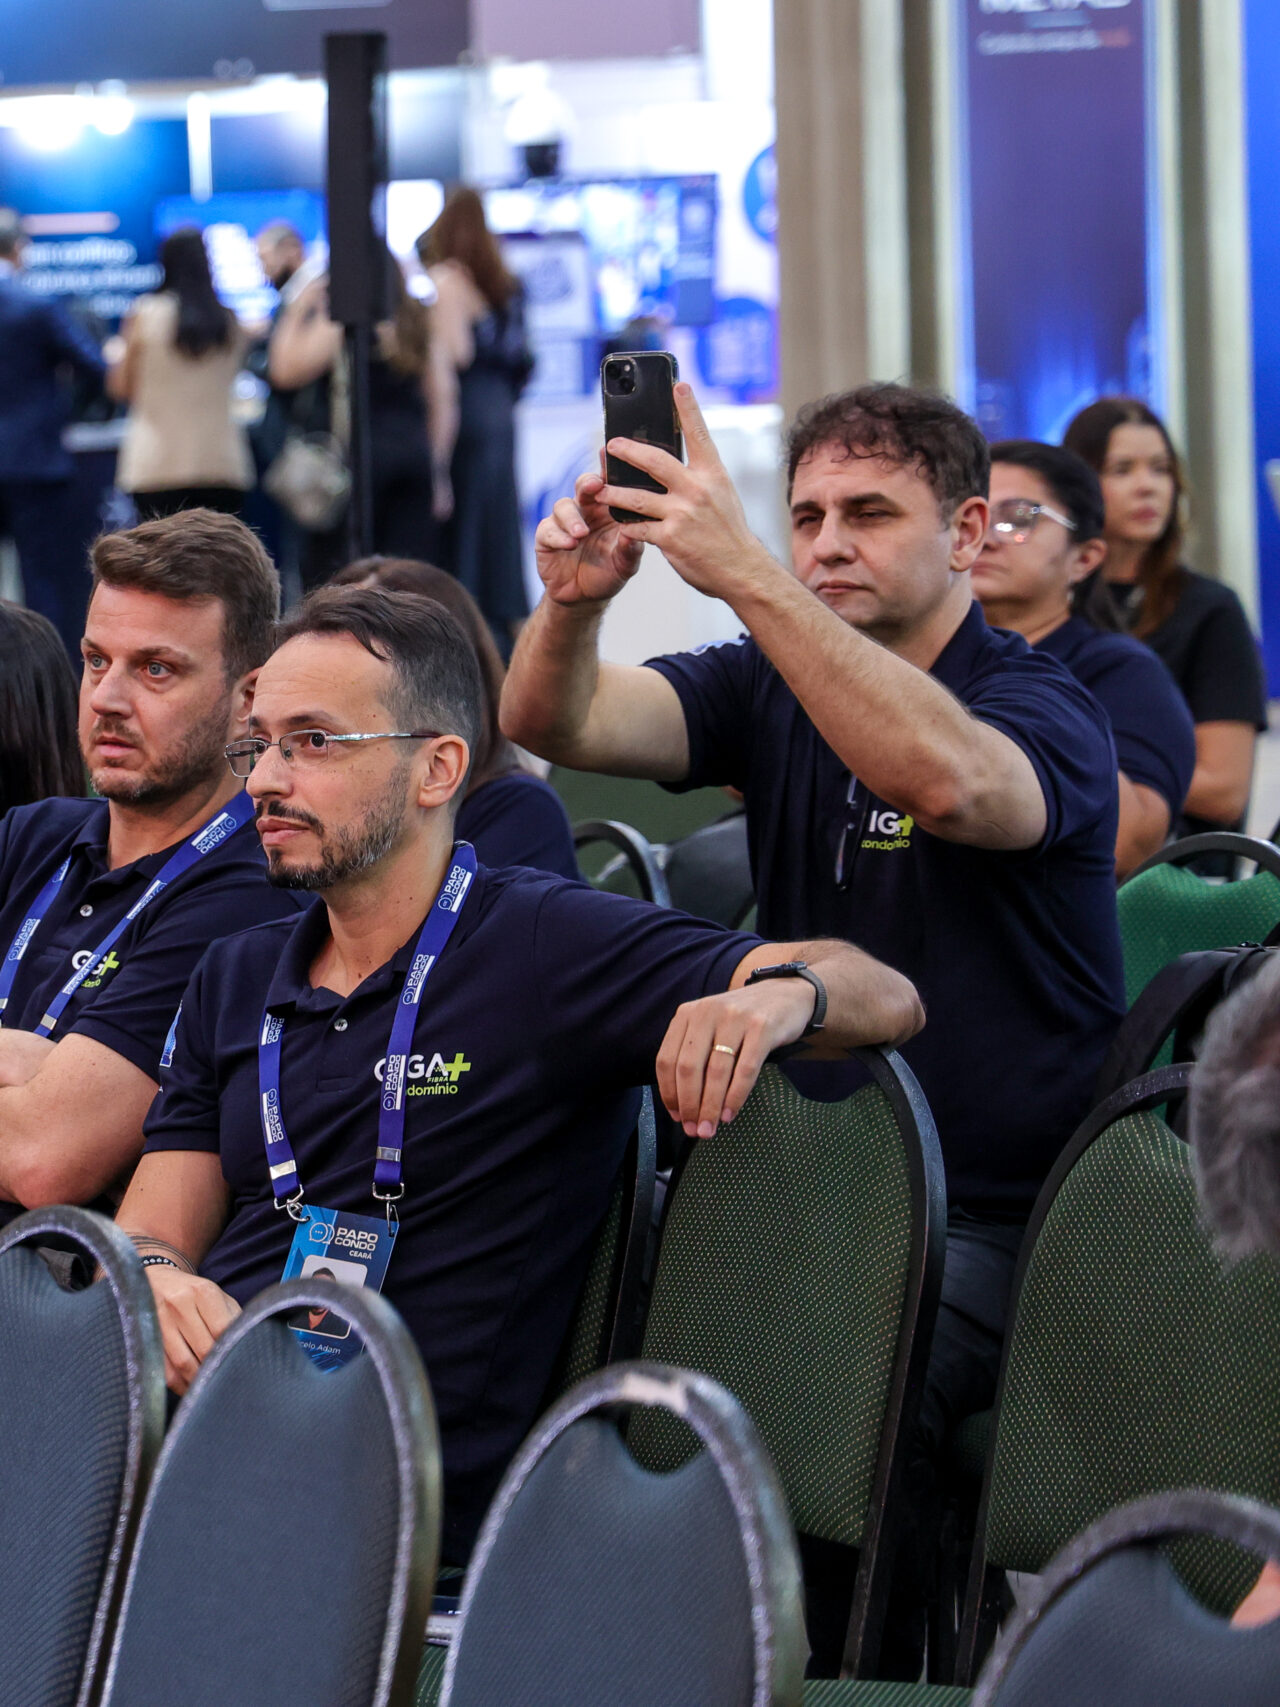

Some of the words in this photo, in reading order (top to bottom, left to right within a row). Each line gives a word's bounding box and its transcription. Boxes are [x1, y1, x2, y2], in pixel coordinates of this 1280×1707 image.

[200, 830, 226, 854] PAPO
[444, 865, 461, 893] PAPO
[451, 868, 467, 895] CONDO
[14, 918, 31, 945] PAPO
[407, 954, 423, 986] PAPO
[413, 954, 429, 986] CONDO
[385, 1054, 396, 1090] PAPO
[391, 1054, 401, 1090] CONDO
[268, 1108, 278, 1142] CONDO
[273, 1105, 284, 1140] PAPO
[334, 1238, 376, 1251] CONDO
[336, 1227, 378, 1243] PAPO
[349, 1250, 372, 1260] CEARÁ
[318, 1344, 341, 1354] Adam
